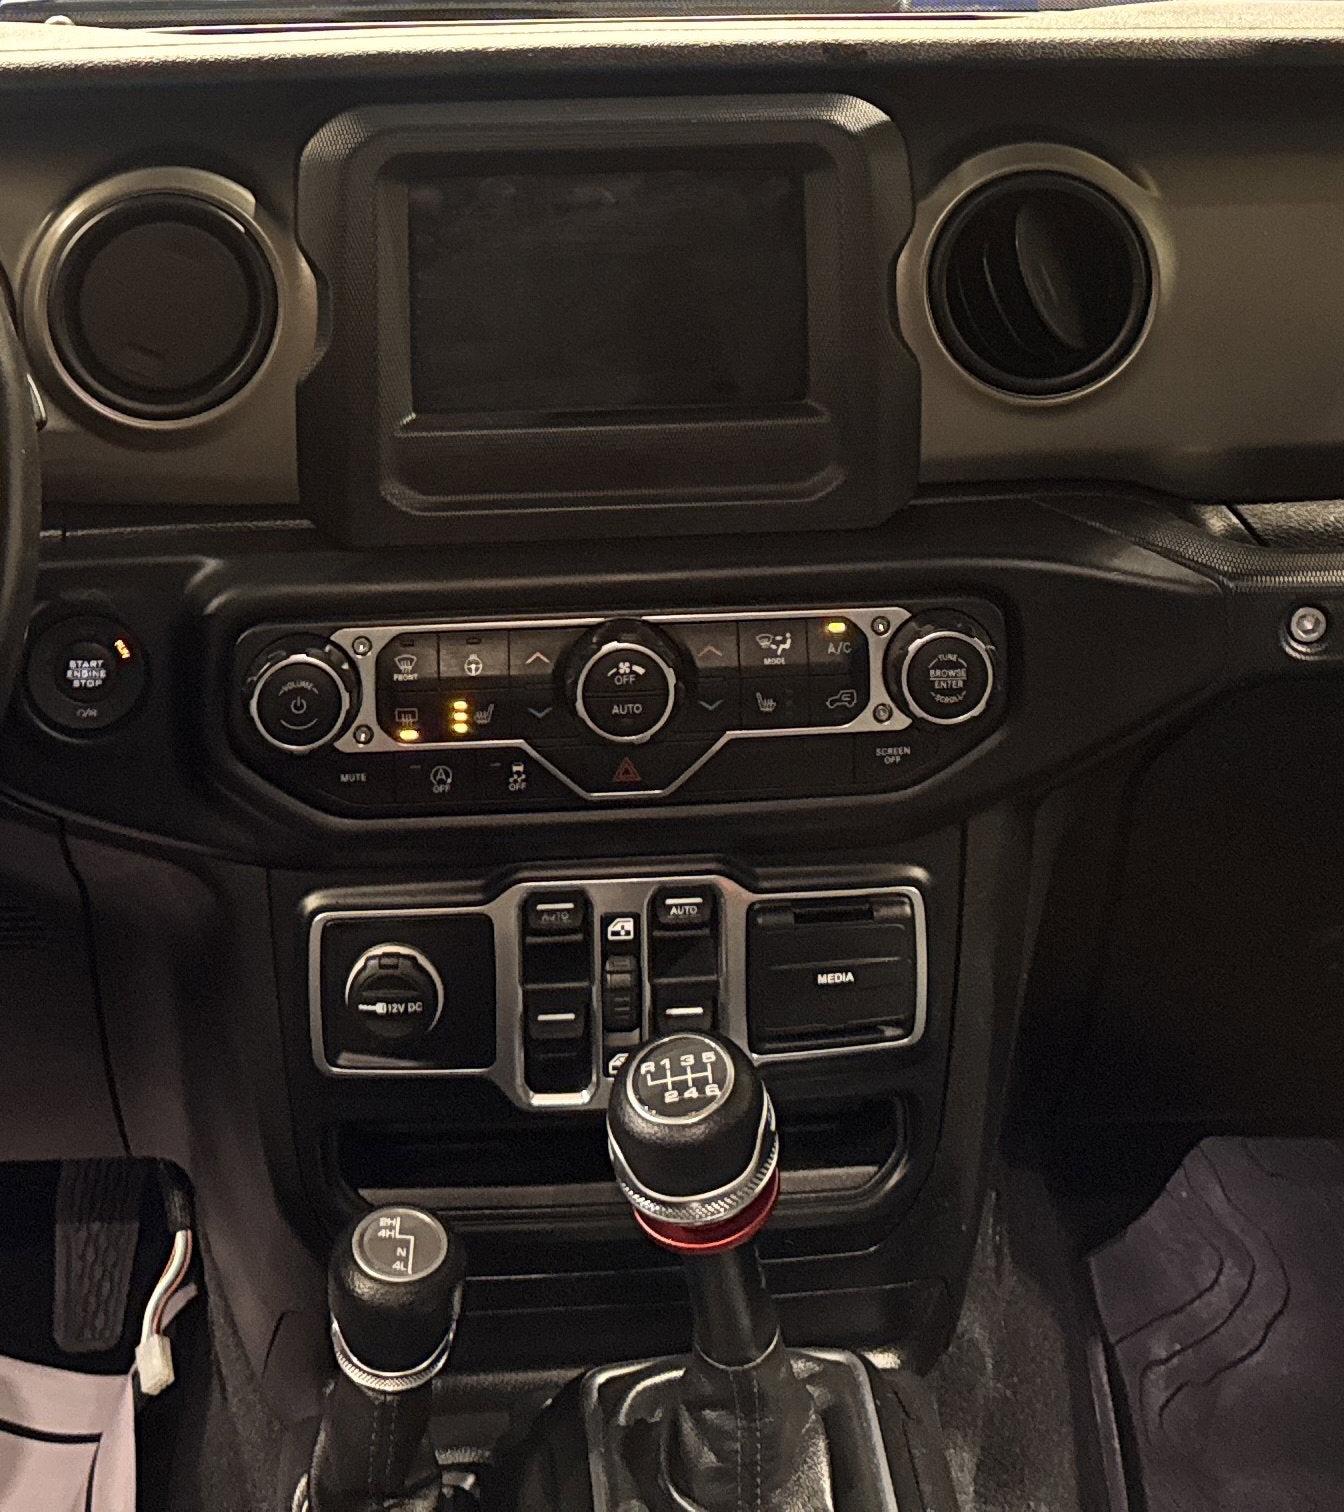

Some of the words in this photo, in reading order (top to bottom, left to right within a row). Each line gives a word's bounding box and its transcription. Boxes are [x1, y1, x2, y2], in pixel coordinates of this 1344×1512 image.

[827, 642, 853, 656] A/C
[69, 659, 105, 669] START
[763, 656, 786, 665] MODE
[66, 669, 107, 680] ENGINE
[393, 673, 419, 682] FRONT
[929, 668, 967, 678] BROWSE
[72, 679, 103, 688] STOP
[614, 674, 637, 687] OFF
[934, 679, 964, 689] ENTER
[611, 703, 644, 716] AUTO
[876, 746, 911, 757] SCREEN
[883, 755, 902, 765] OFF
[339, 772, 368, 783] MUTE
[432, 784, 452, 794] OFF
[508, 782, 528, 792] OFF
[669, 904, 699, 915] AUTO
[816, 972, 855, 986] MEDIA
[387, 1001, 405, 1014] 12V
[407, 1001, 423, 1014] DC
[640, 1061, 655, 1075] R
[660, 1057, 671, 1070] 1
[680, 1054, 695, 1067] 3
[701, 1051, 716, 1063] 5
[664, 1090, 679, 1104] 2
[683, 1086, 699, 1099] 4
[705, 1083, 721, 1097] 6
[377, 1228, 395, 1239] 4H
[396, 1247, 407, 1257] N
[391, 1260, 407, 1271] 4L
